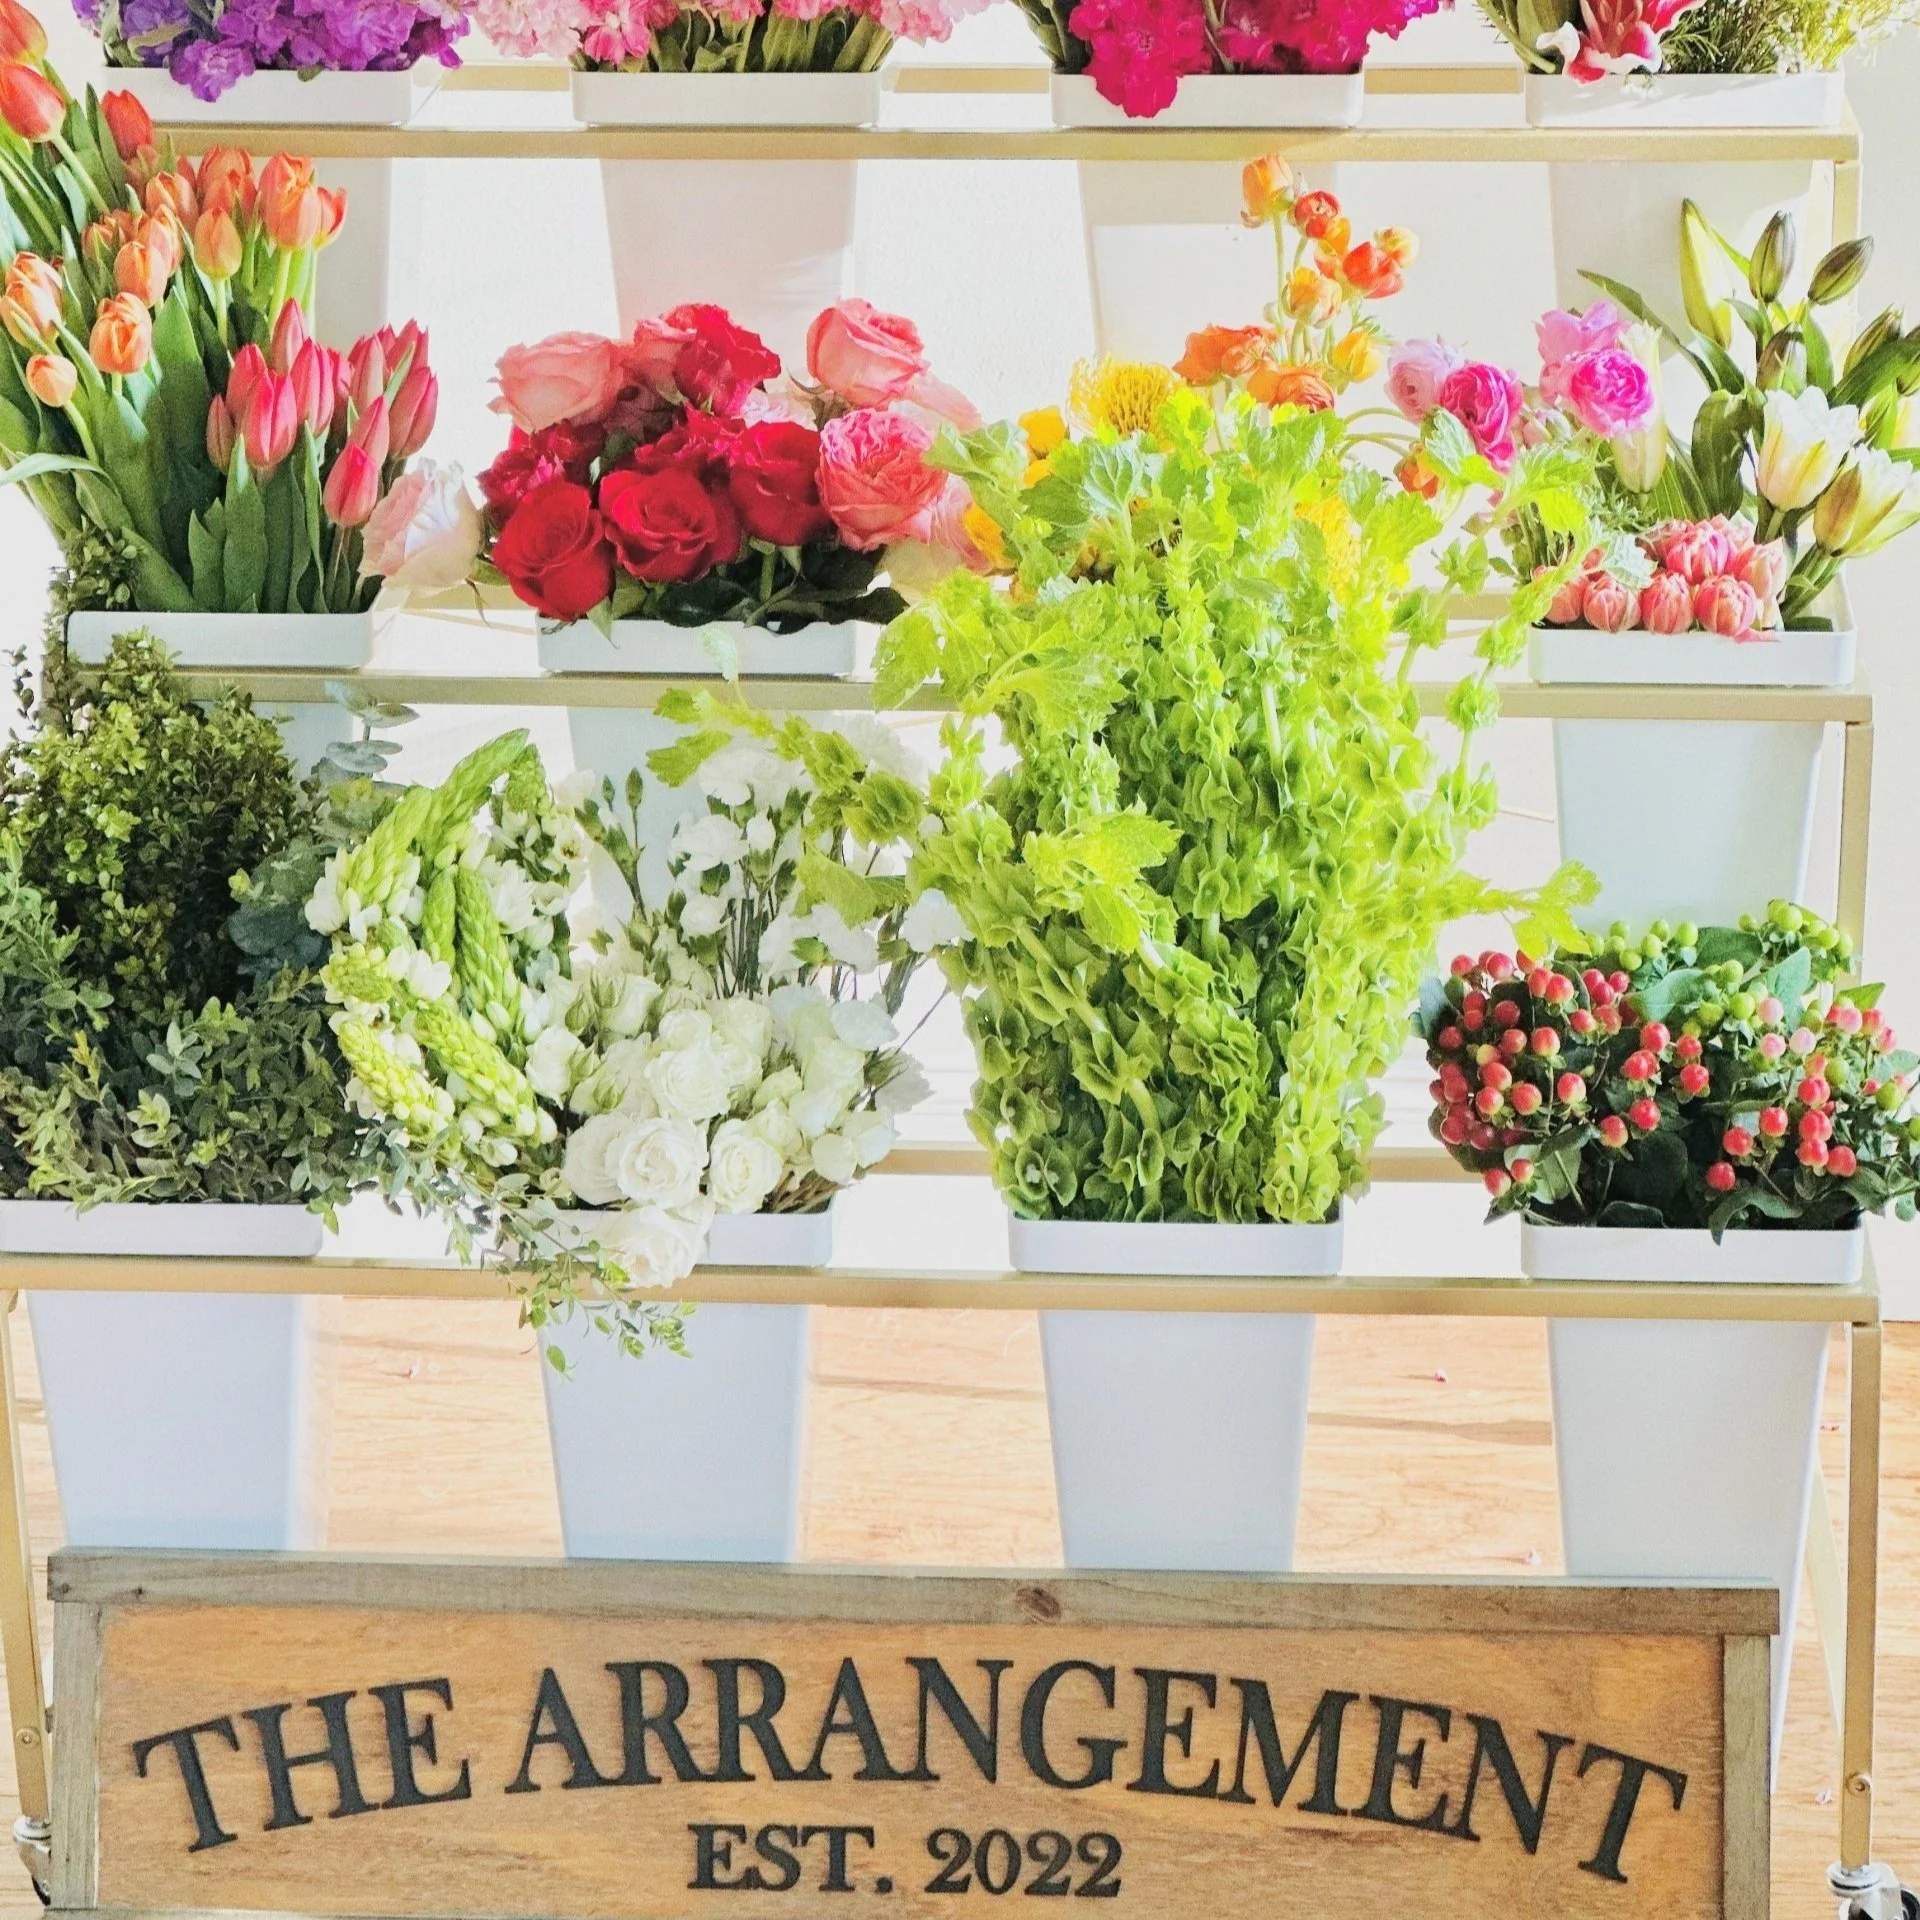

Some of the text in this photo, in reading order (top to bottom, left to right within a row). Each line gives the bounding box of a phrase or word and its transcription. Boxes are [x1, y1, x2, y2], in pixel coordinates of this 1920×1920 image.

[132, 1656, 1689, 1886] THE ARRANGEMENT
[687, 1823, 1123, 1898] EST. 2022
